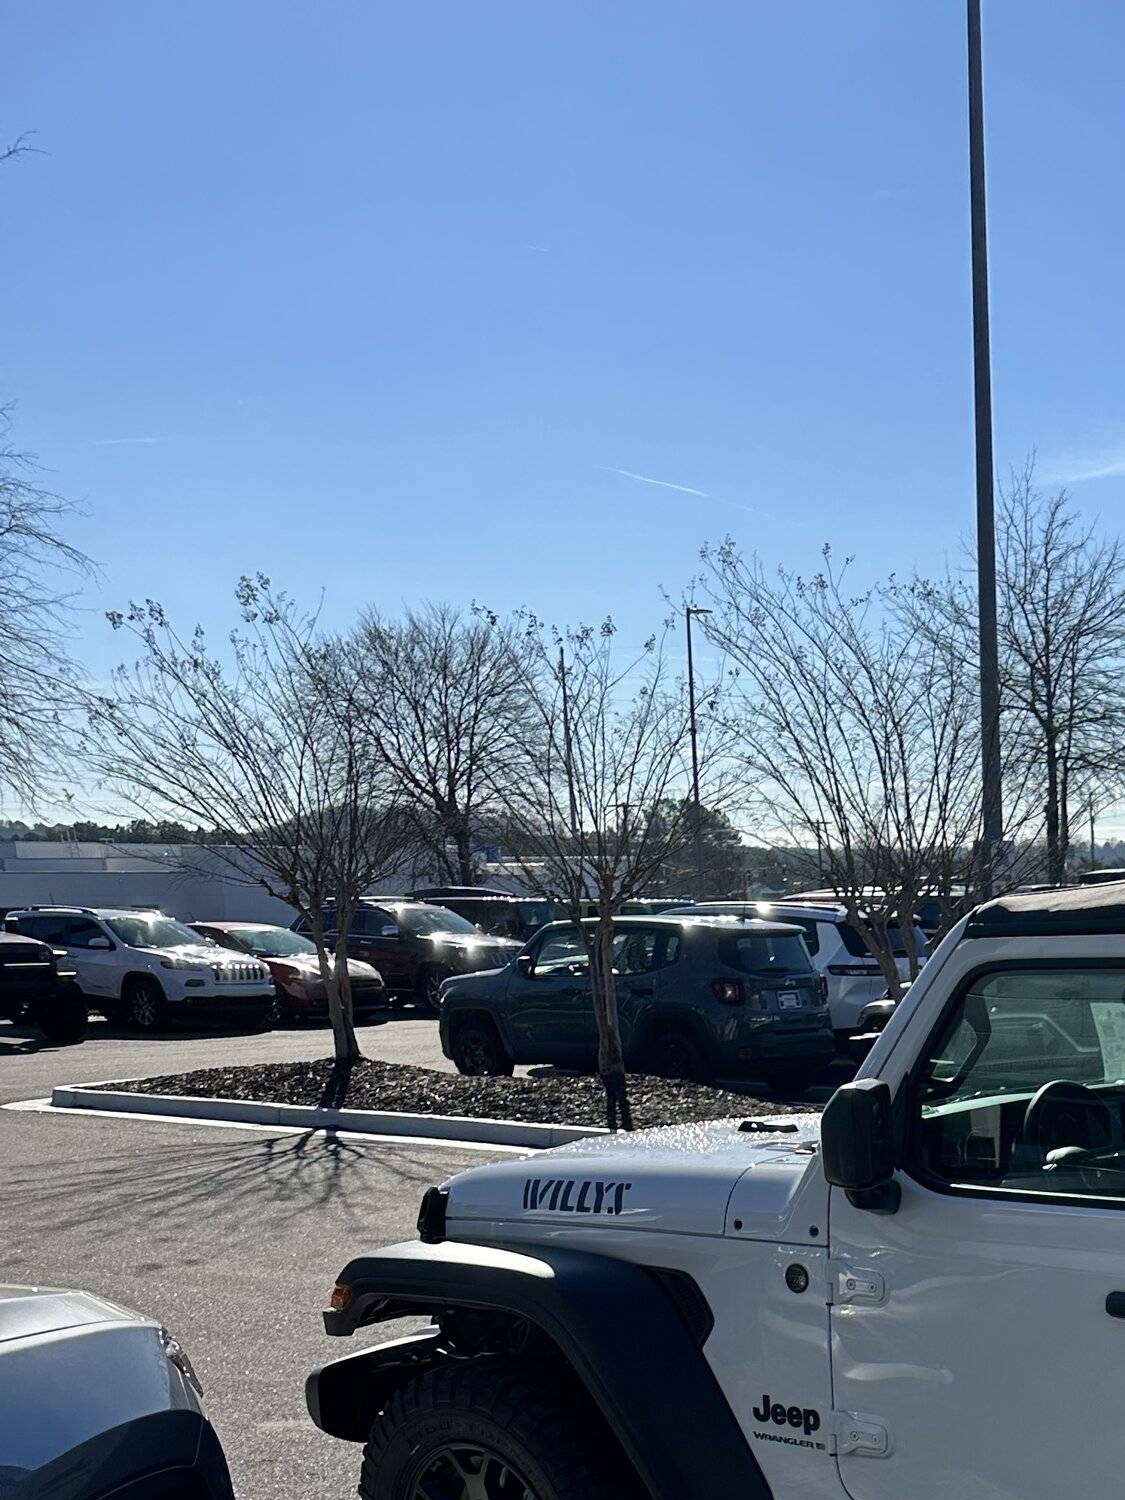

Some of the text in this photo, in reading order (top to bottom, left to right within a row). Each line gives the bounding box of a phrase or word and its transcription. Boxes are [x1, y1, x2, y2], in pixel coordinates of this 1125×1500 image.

[523, 1179, 632, 1215] WILLYS
[753, 1394, 820, 1435] Jeep
[753, 1431, 814, 1448] WRANGLER
